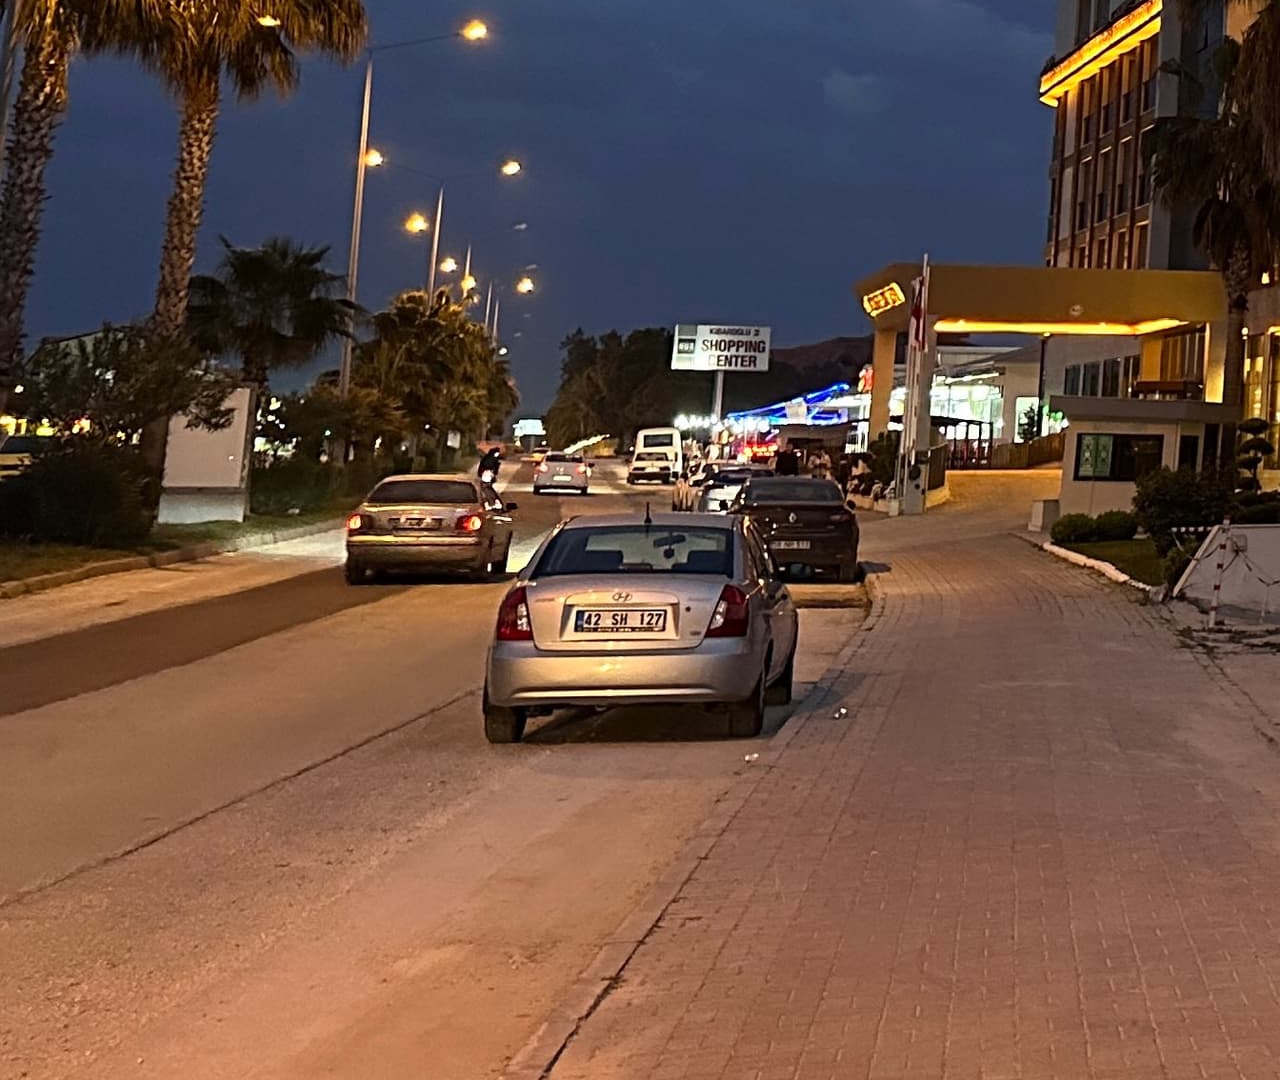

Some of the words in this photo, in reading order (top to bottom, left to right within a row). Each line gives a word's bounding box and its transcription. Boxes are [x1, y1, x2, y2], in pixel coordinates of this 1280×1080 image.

[701, 339, 766, 353] SHOPPING
[584, 612, 601, 627] 42
[611, 612, 628, 627] SH
[639, 612, 663, 627] 127
